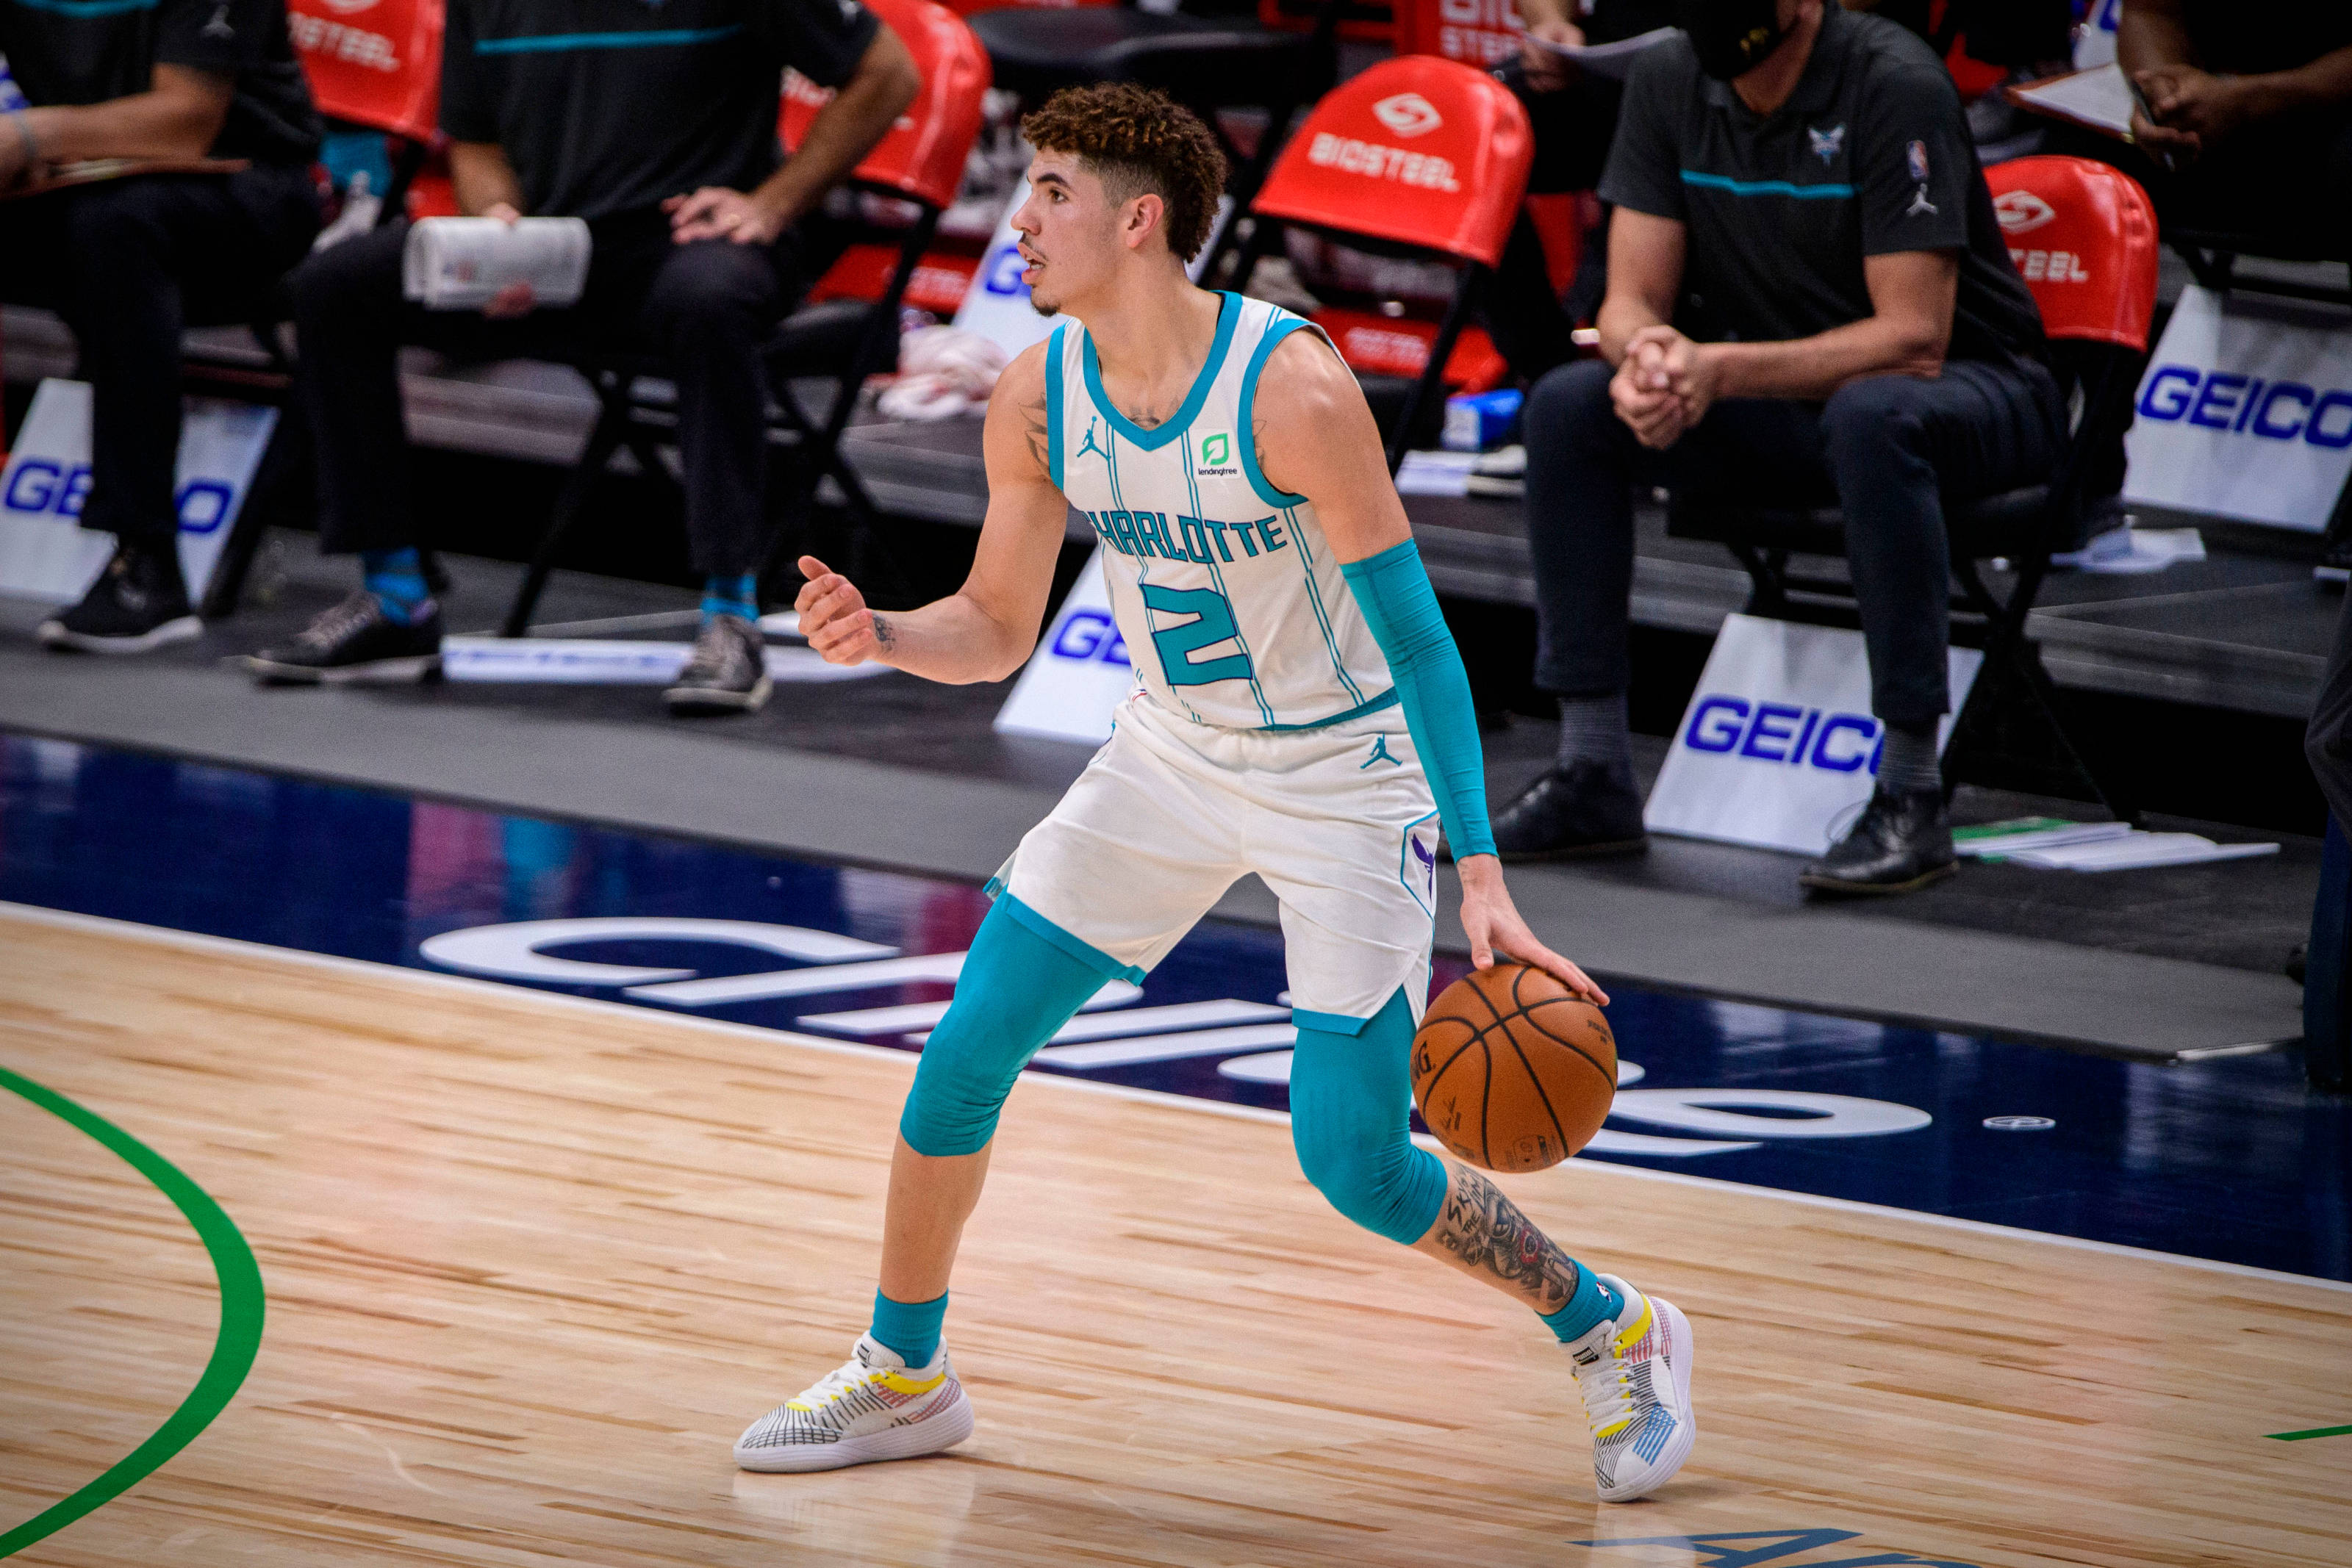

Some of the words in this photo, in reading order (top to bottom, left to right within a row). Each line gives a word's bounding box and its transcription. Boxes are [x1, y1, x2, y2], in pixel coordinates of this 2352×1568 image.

[1308, 132, 1461, 193] BIOSTEEL
[2139, 367, 2352, 449] GEICO
[4, 461, 234, 534] GEO
[1197, 467, 1238, 477] lendingtree
[1139, 583, 1254, 686] 2
[1685, 694, 1885, 775] GEIC
